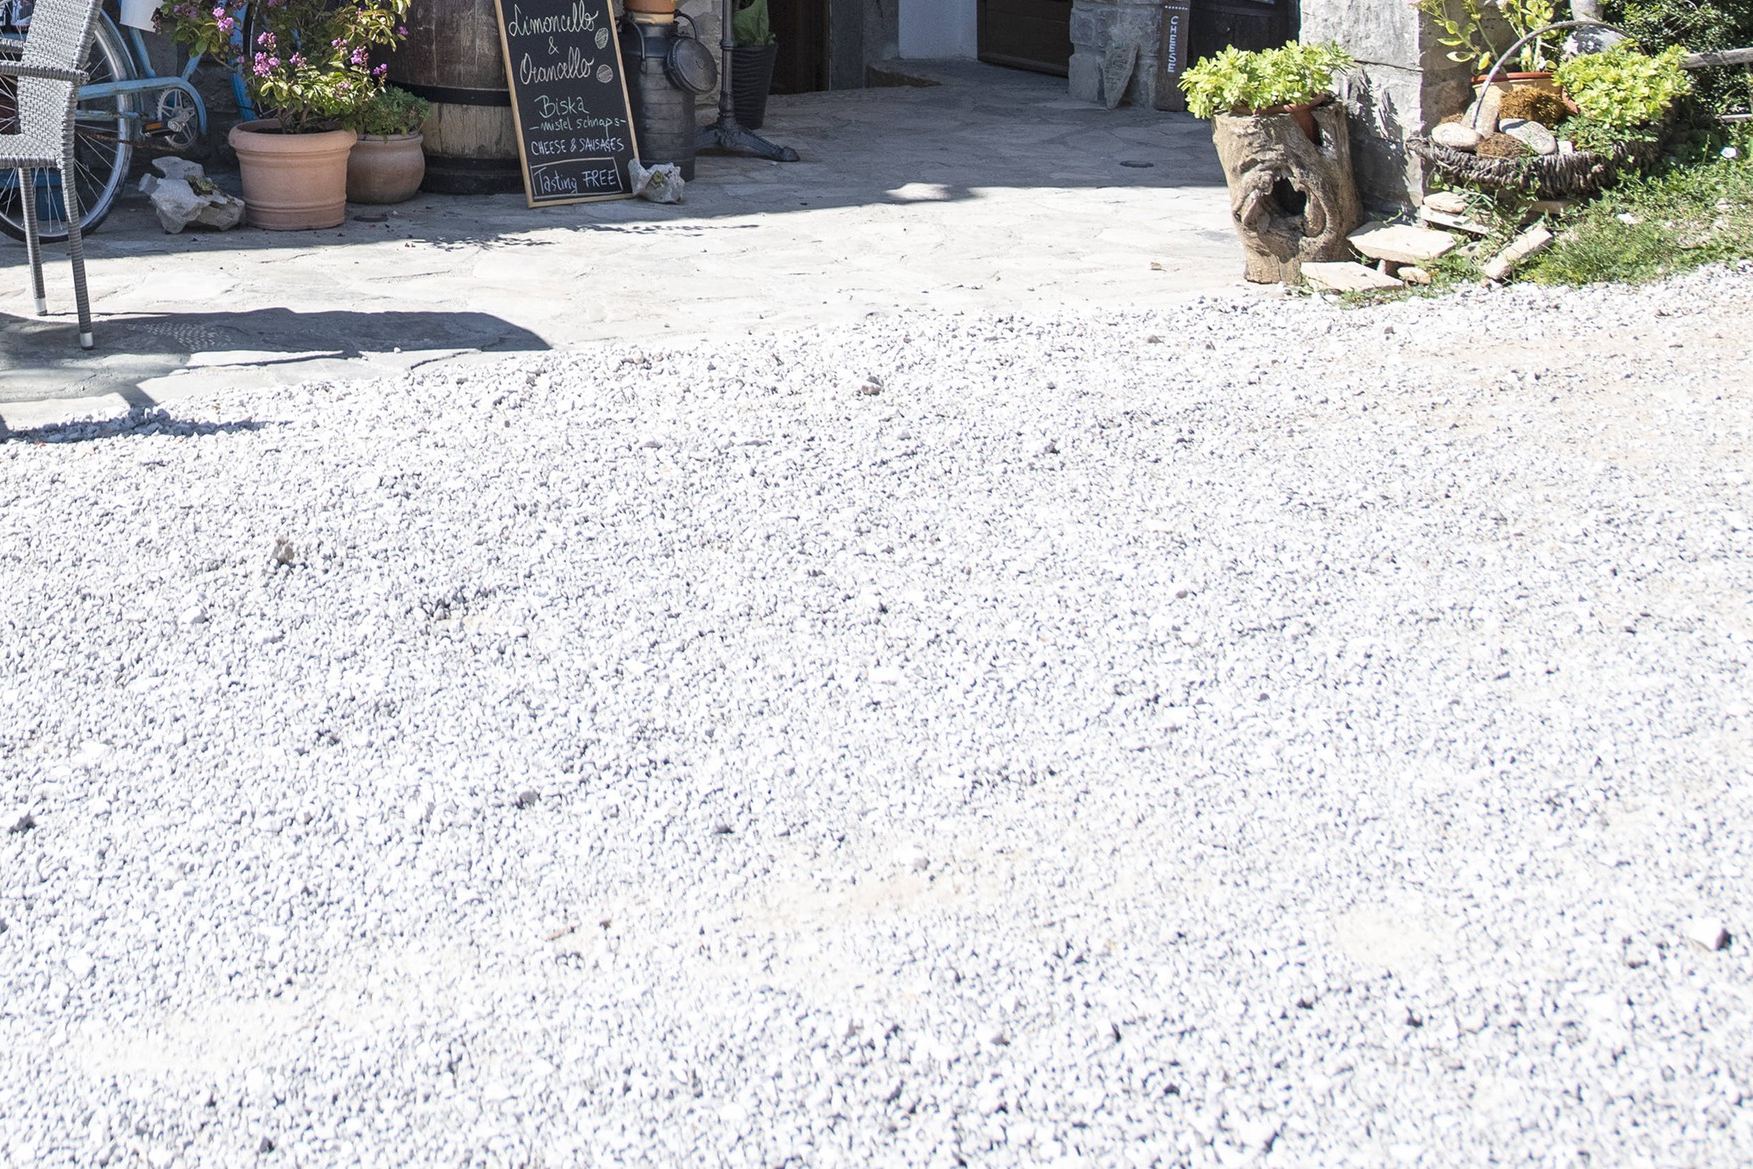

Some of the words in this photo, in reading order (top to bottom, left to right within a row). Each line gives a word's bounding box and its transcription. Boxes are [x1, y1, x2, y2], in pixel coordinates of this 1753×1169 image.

[547, 36, 560, 55] &
[1167, 15, 1180, 74] CHEESE
[534, 94, 590, 119] Biska
[530, 138, 567, 156] CHEESE
[570, 138, 578, 153] &
[533, 167, 578, 195] Tasting
[582, 169, 616, 189] FREE
